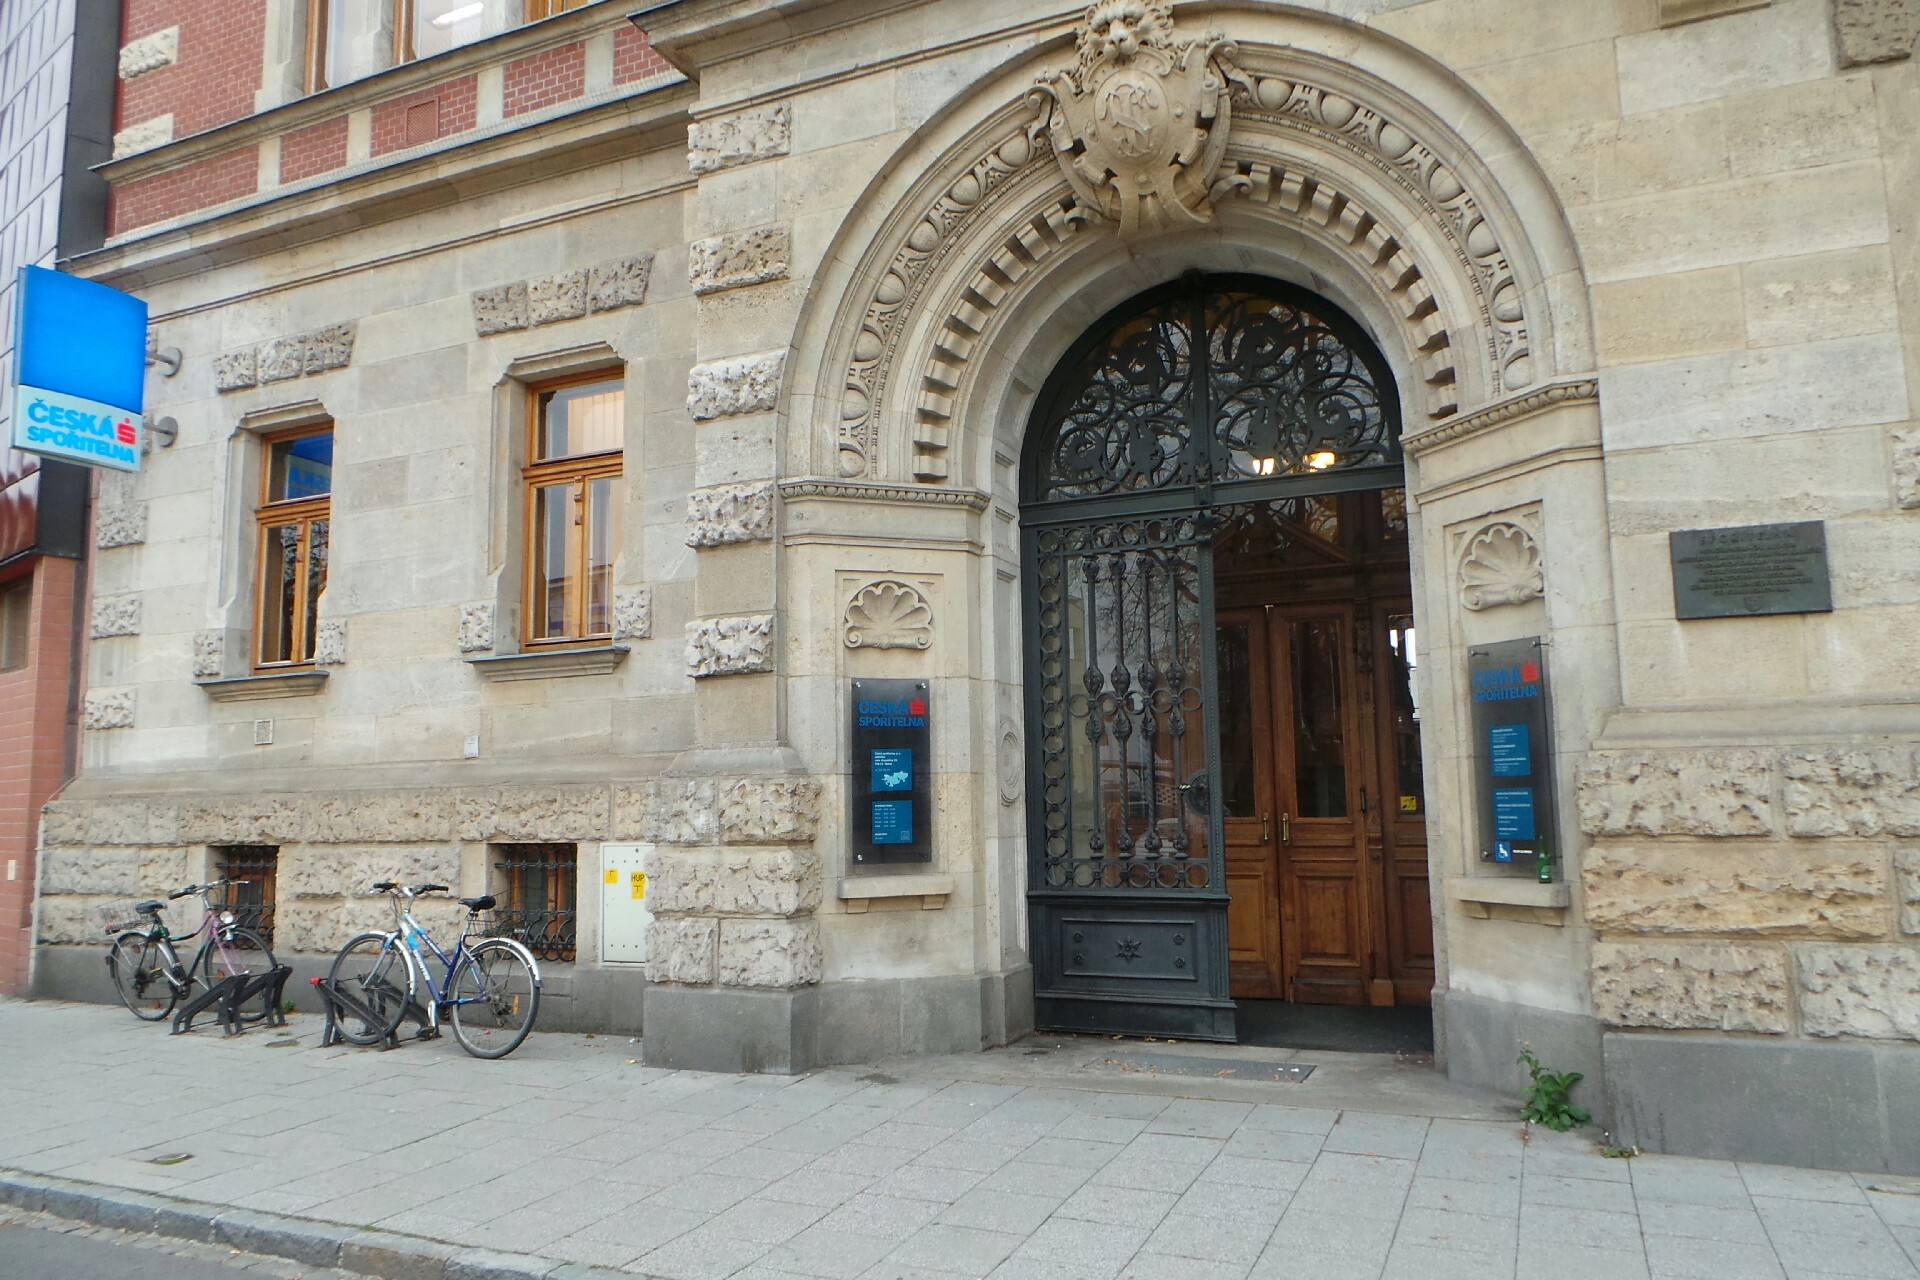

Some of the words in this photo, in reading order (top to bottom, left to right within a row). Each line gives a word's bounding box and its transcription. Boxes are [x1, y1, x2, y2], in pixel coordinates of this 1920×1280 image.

[28, 398, 115, 440] ČESKÁ
[27, 426, 135, 464] SPOŘITELNA
[859, 714, 925, 727] SPOŘITELNA
